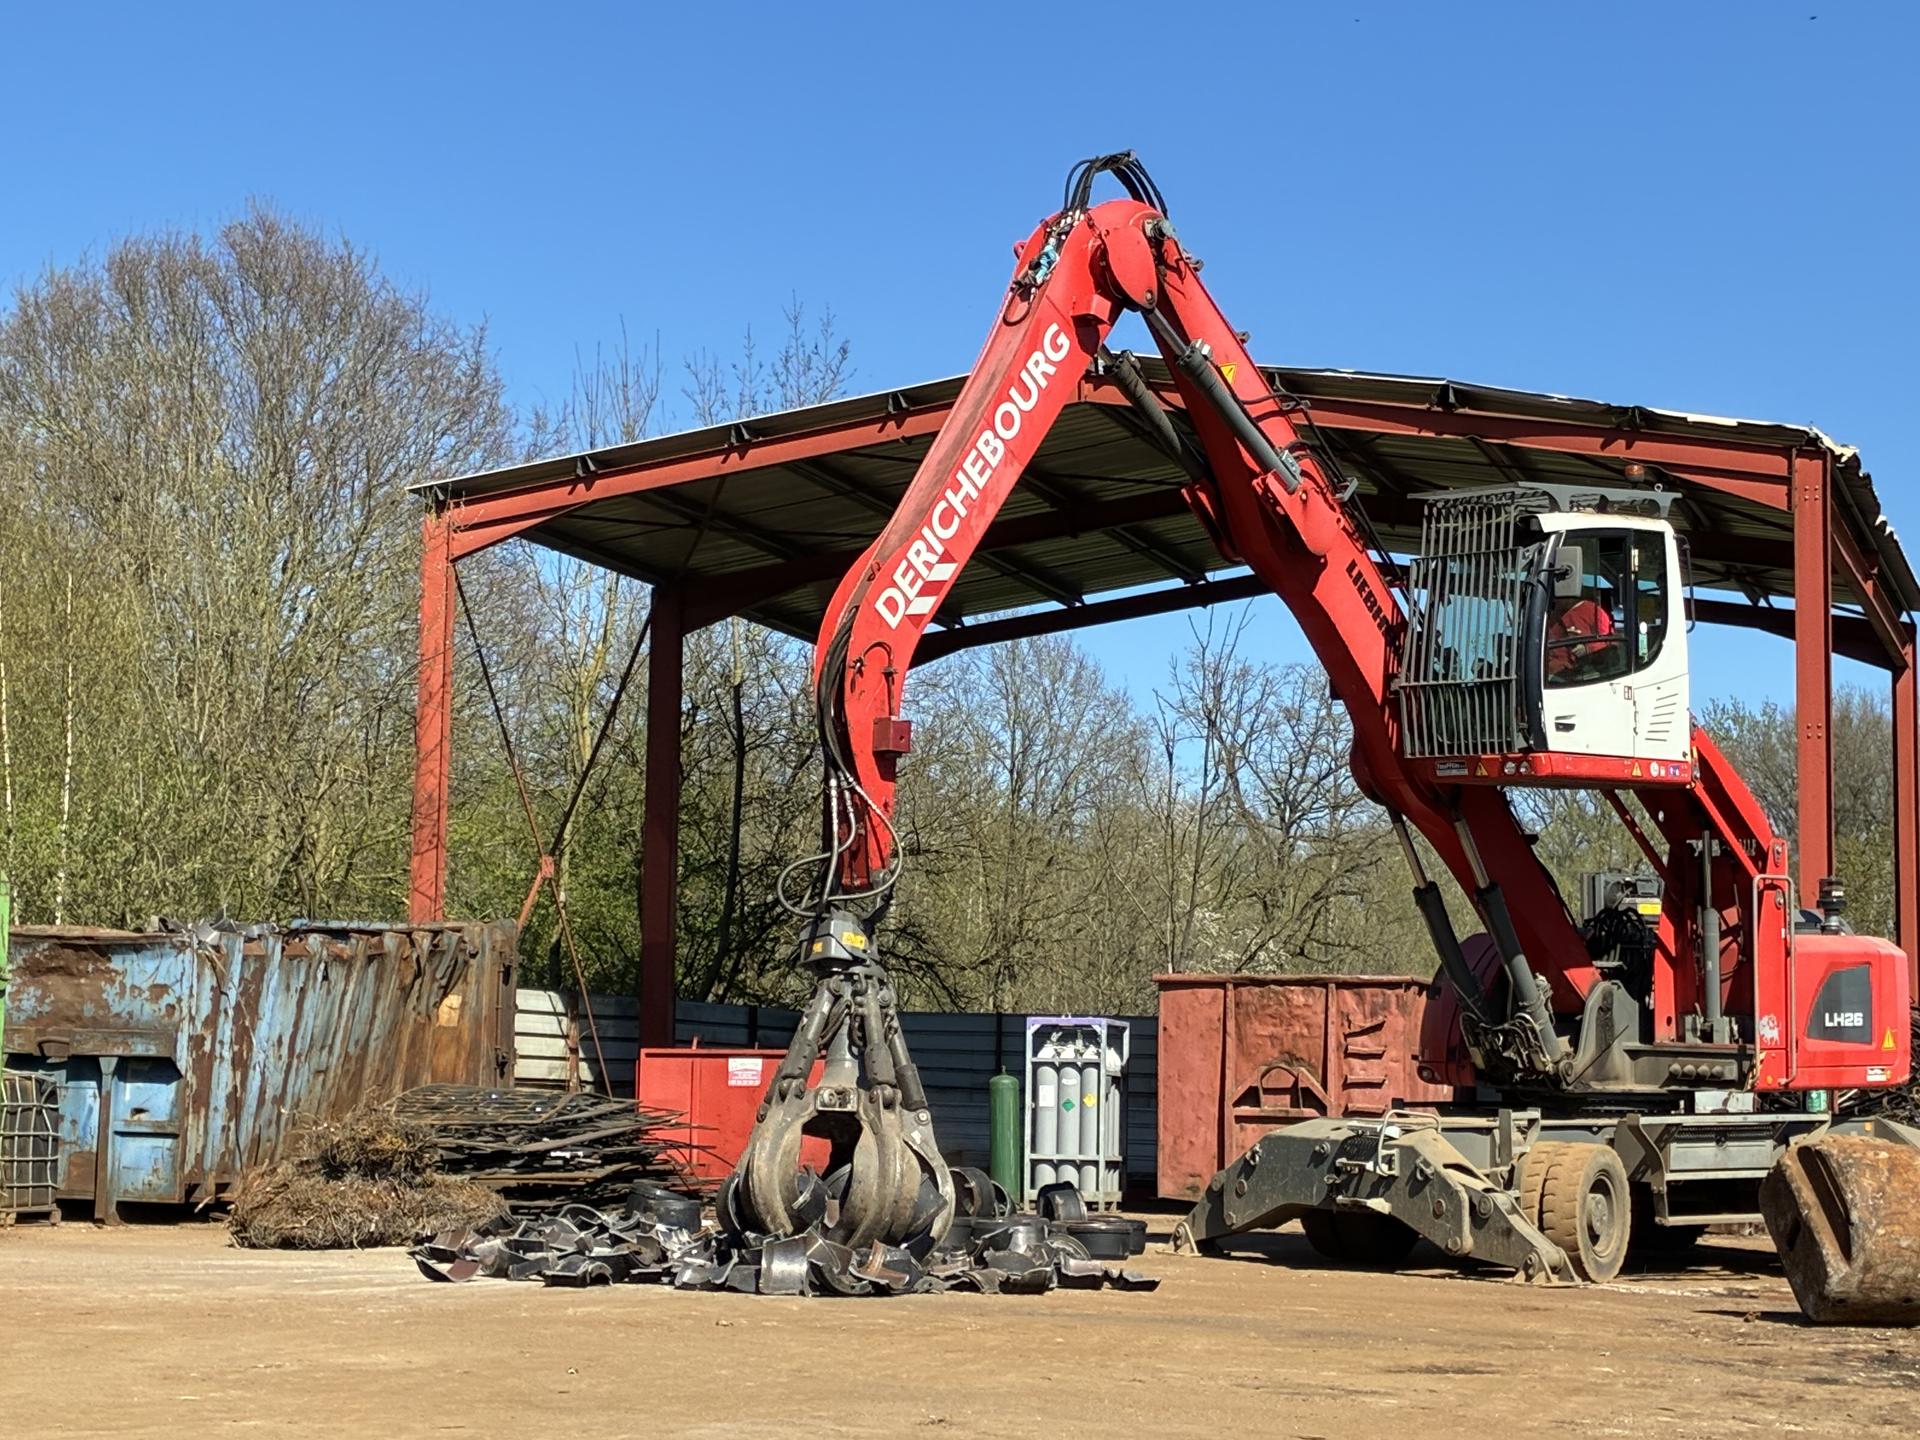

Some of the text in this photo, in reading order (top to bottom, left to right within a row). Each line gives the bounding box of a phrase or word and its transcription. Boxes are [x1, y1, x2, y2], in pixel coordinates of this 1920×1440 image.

[874, 322, 1071, 630] DERICHEBOURG
[1345, 558, 1390, 634] LIEBH
[1825, 1012, 1863, 1027] LH26
